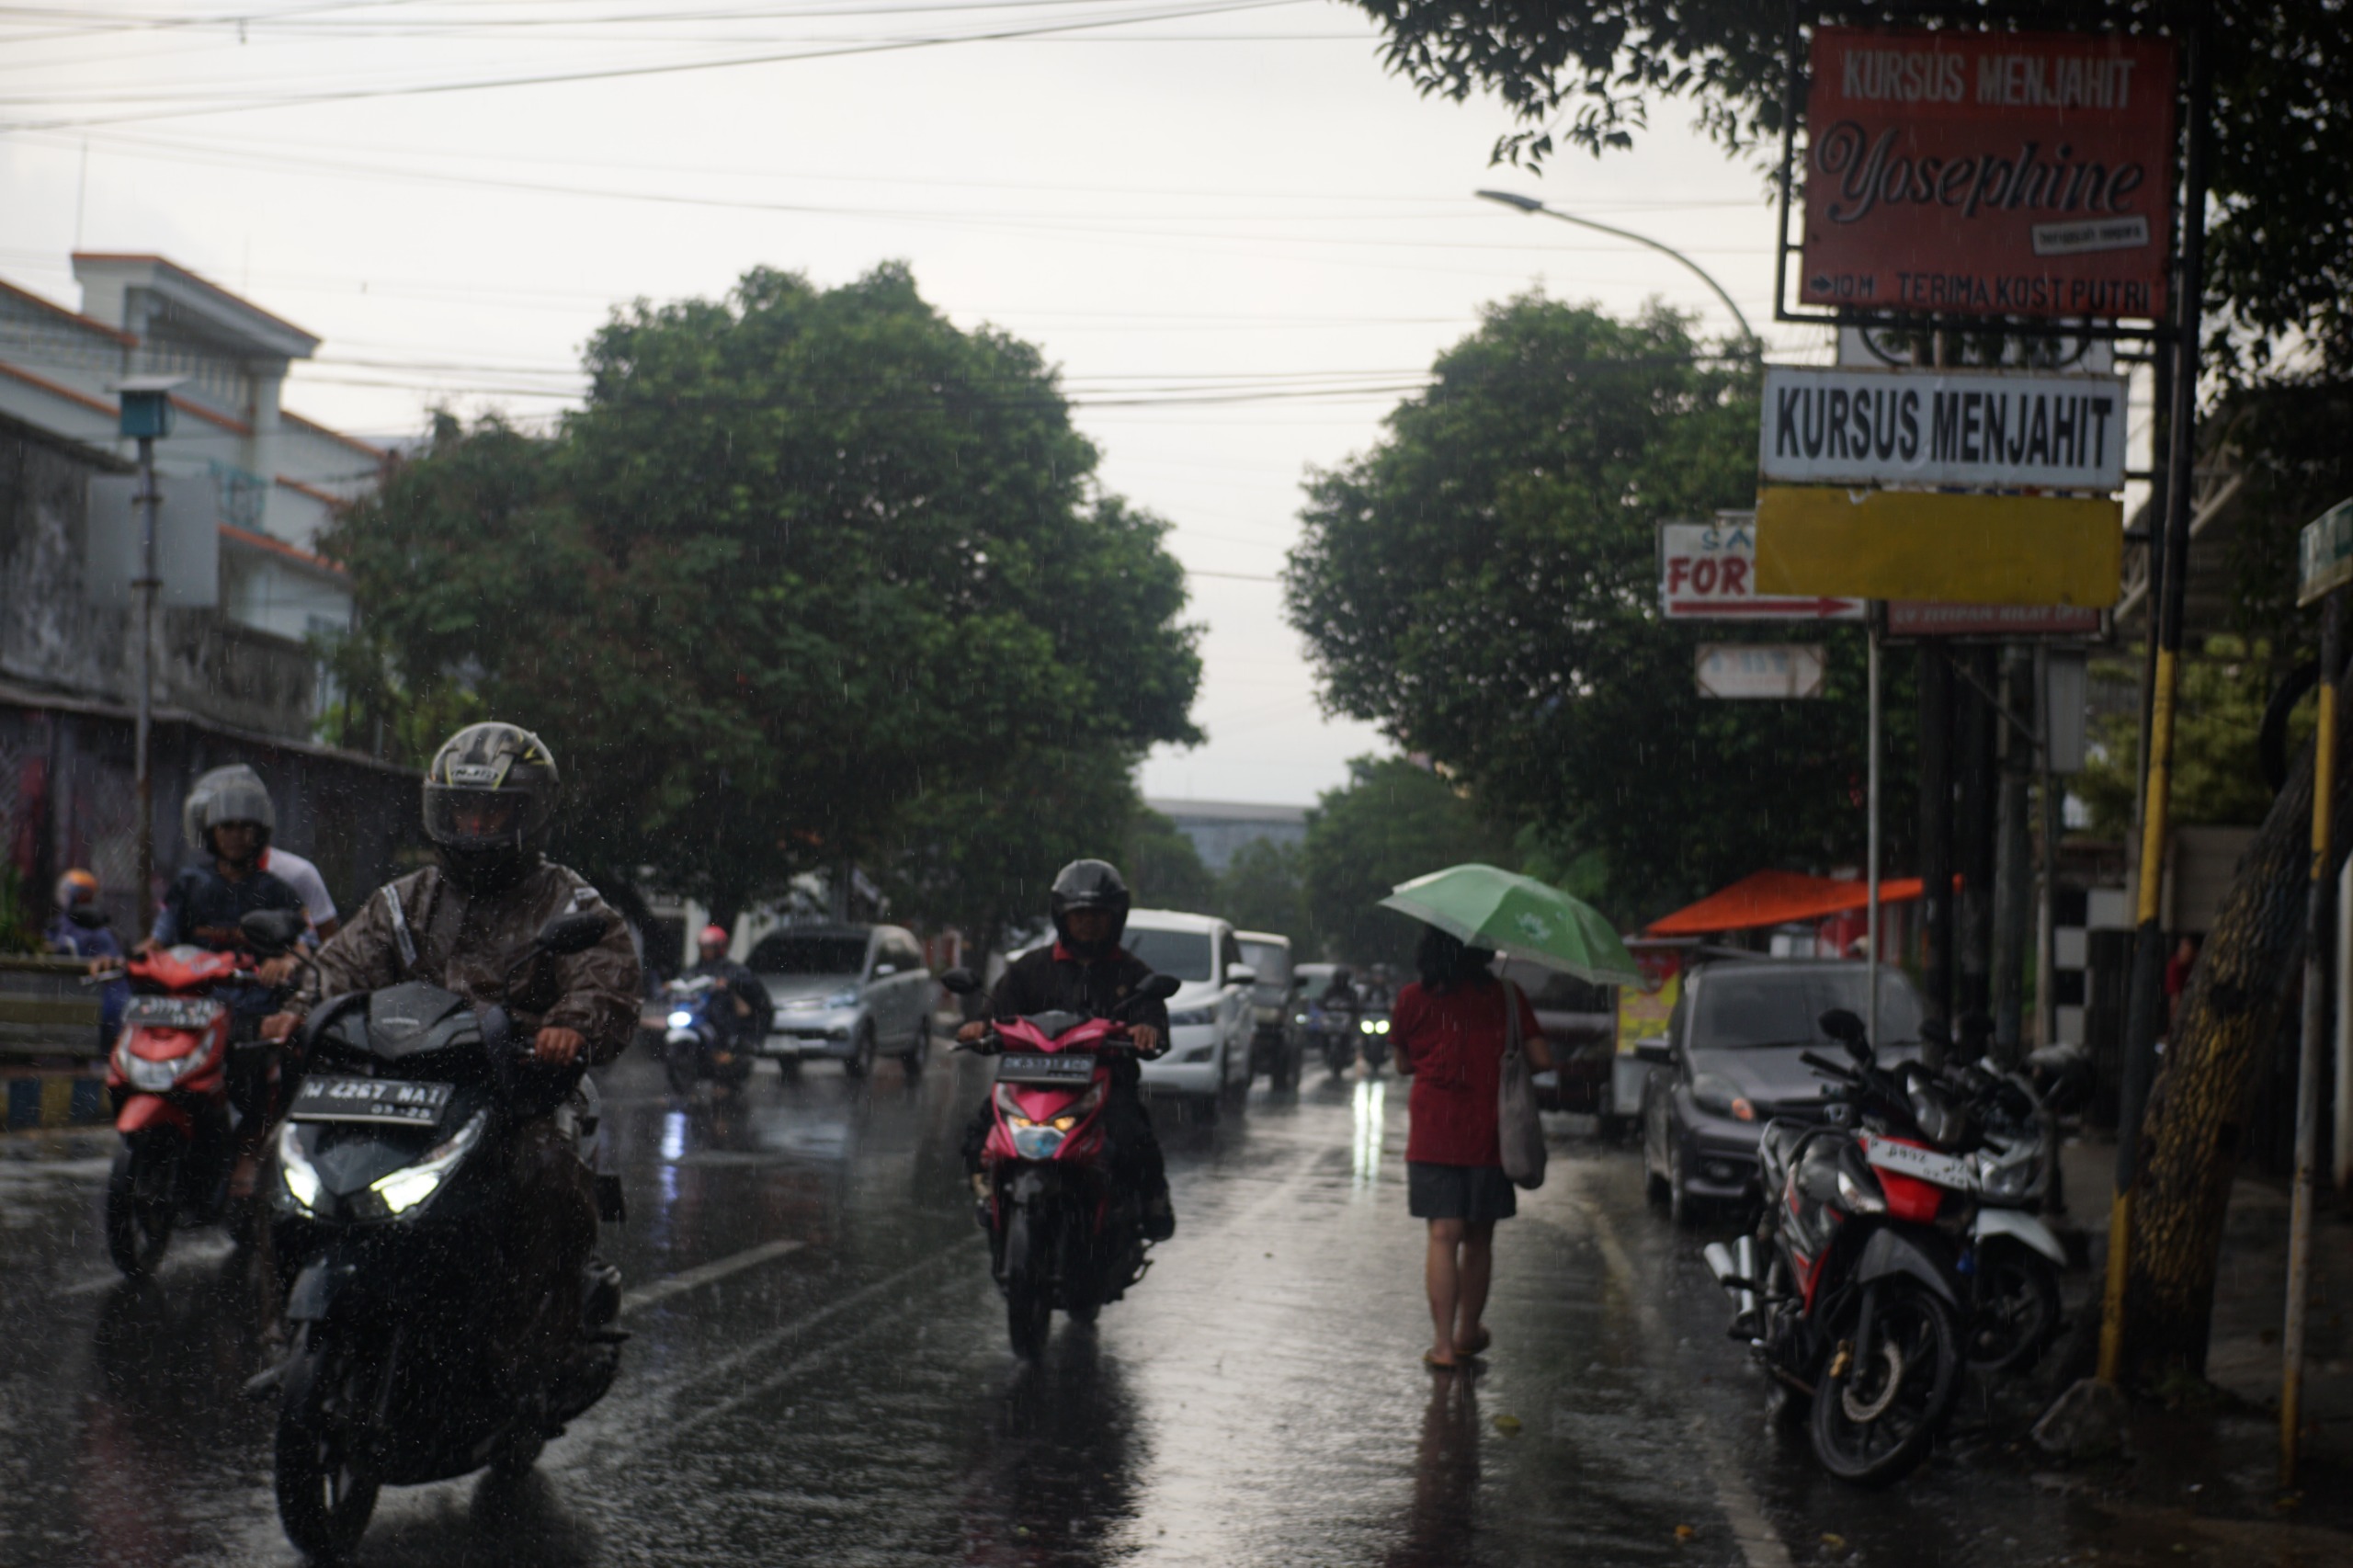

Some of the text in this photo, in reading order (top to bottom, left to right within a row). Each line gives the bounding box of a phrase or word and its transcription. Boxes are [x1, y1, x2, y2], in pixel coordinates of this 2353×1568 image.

[1842, 50, 2137, 109] KURSUS MENJAHIT
[1814, 119, 2145, 224] Yosephine
[1899, 274, 1992, 306] TERIMA
[1995, 277, 2064, 309] KOST
[2071, 279, 2149, 312] PUTRI
[1776, 387, 2113, 468] KURSUS MENJAHIT
[1667, 556, 1755, 596] FOR
